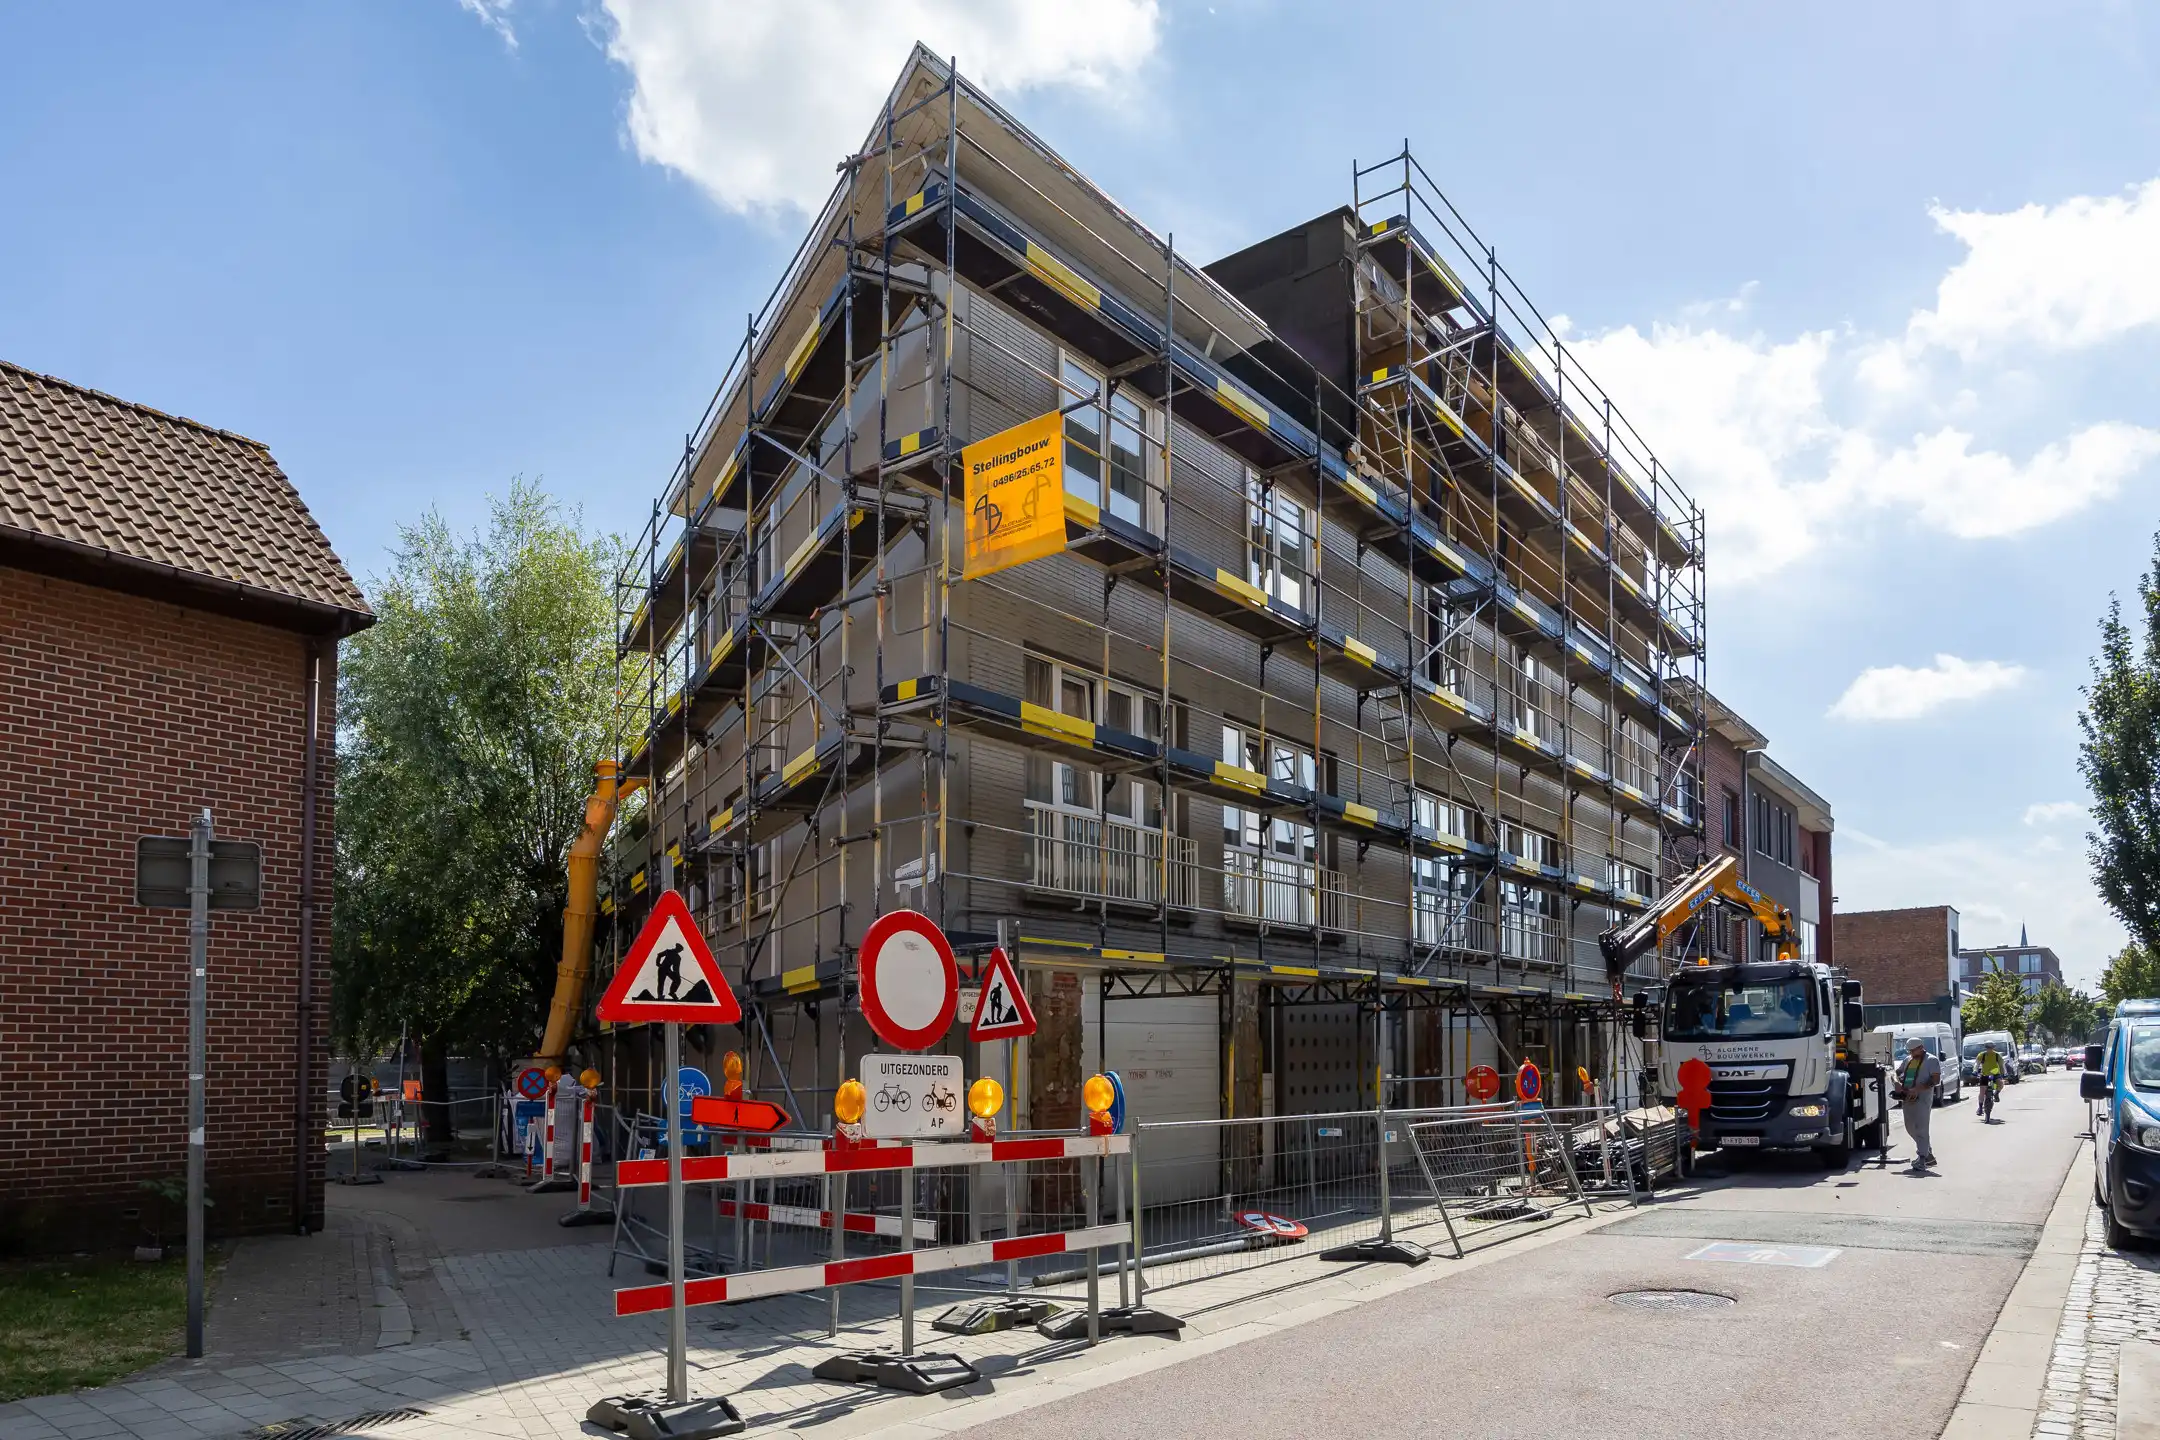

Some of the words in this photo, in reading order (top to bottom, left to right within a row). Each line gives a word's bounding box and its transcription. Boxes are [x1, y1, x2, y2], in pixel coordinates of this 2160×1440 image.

[973, 438, 1049, 475] Stellingbouw
[1690, 885, 1714, 909] EFFER
[1737, 880, 1760, 901] EFFER
[1717, 1052, 1776, 1060] BOUWWERKEN
[880, 1063, 949, 1076] UITGEZONDERD
[1718, 1070, 1756, 1078] DAF
